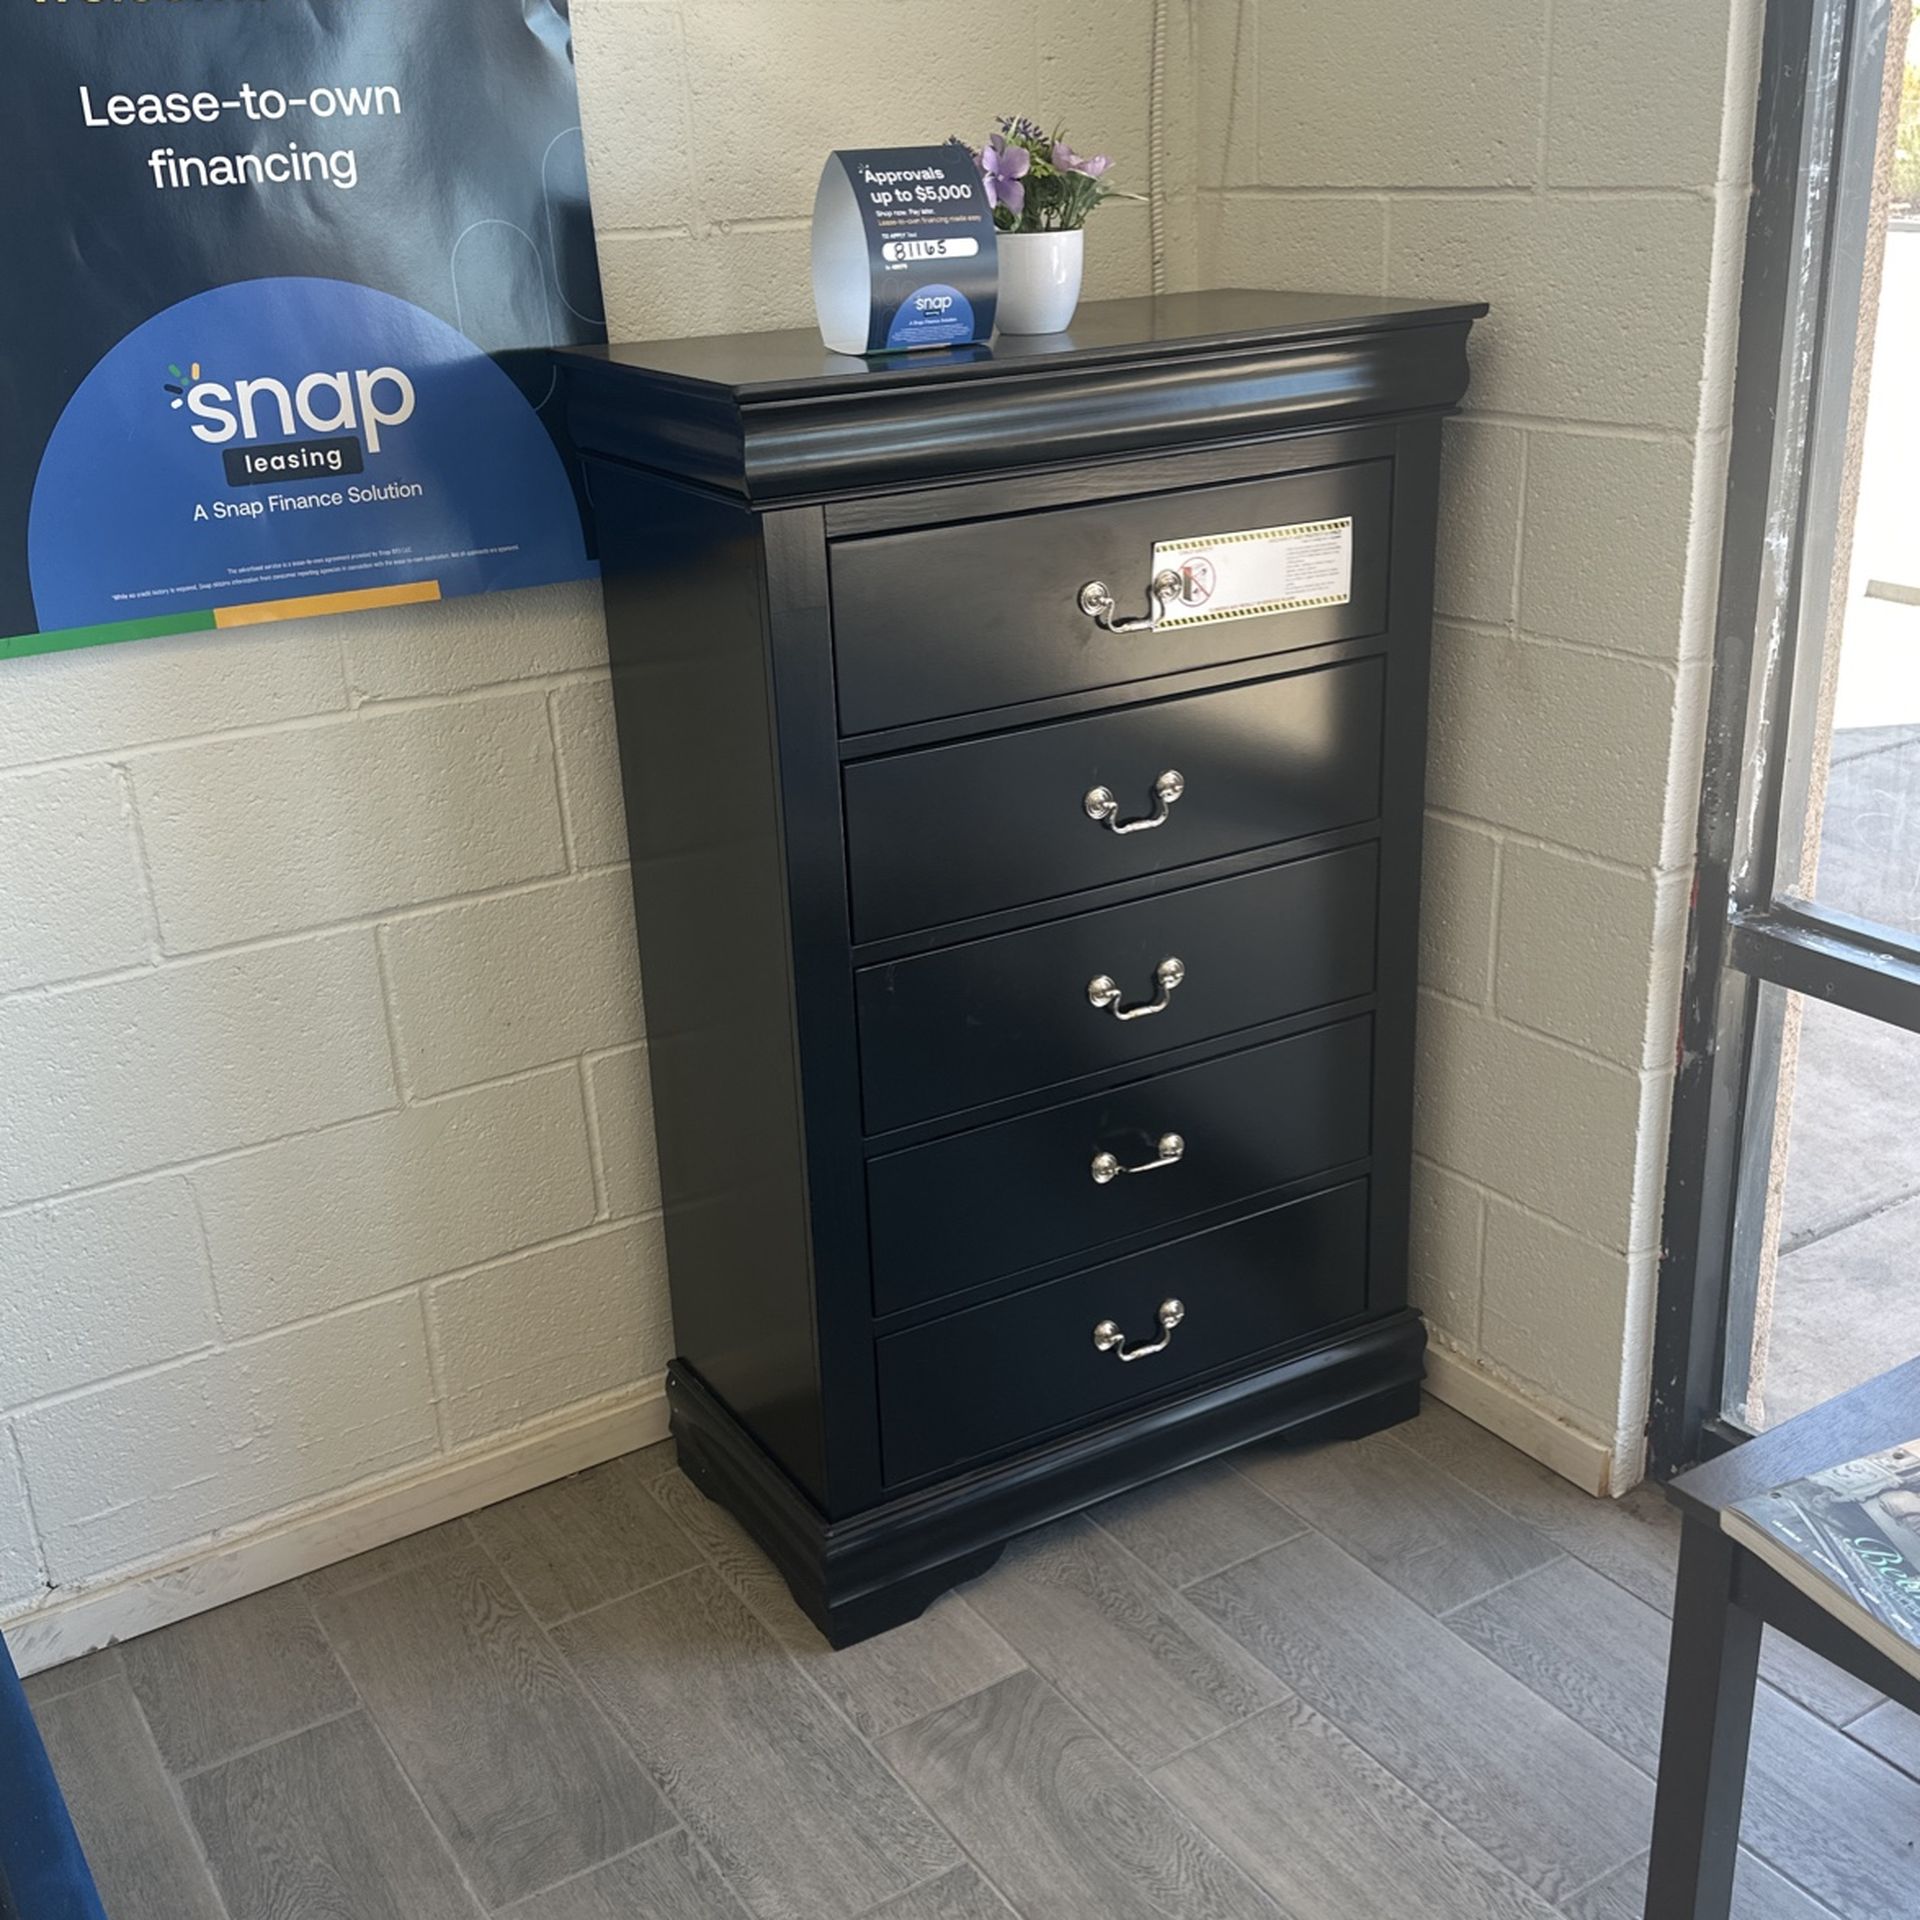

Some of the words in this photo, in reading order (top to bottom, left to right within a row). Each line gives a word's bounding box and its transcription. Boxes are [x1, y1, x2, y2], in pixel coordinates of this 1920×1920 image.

[79, 83, 402, 127] Lease-to-own
[148, 142, 358, 190] financing
[865, 166, 945, 186] Approvals
[870, 191, 893, 207] up
[894, 188, 913, 203] to
[894, 239, 947, 262] 81165
[916, 295, 952, 314] snap
[187, 366, 416, 454] snap
[244, 448, 343, 474] leasing
[193, 504, 209, 522] A
[213, 499, 264, 519] Snap
[267, 490, 343, 513] Finance
[347, 481, 423, 505] Solution
